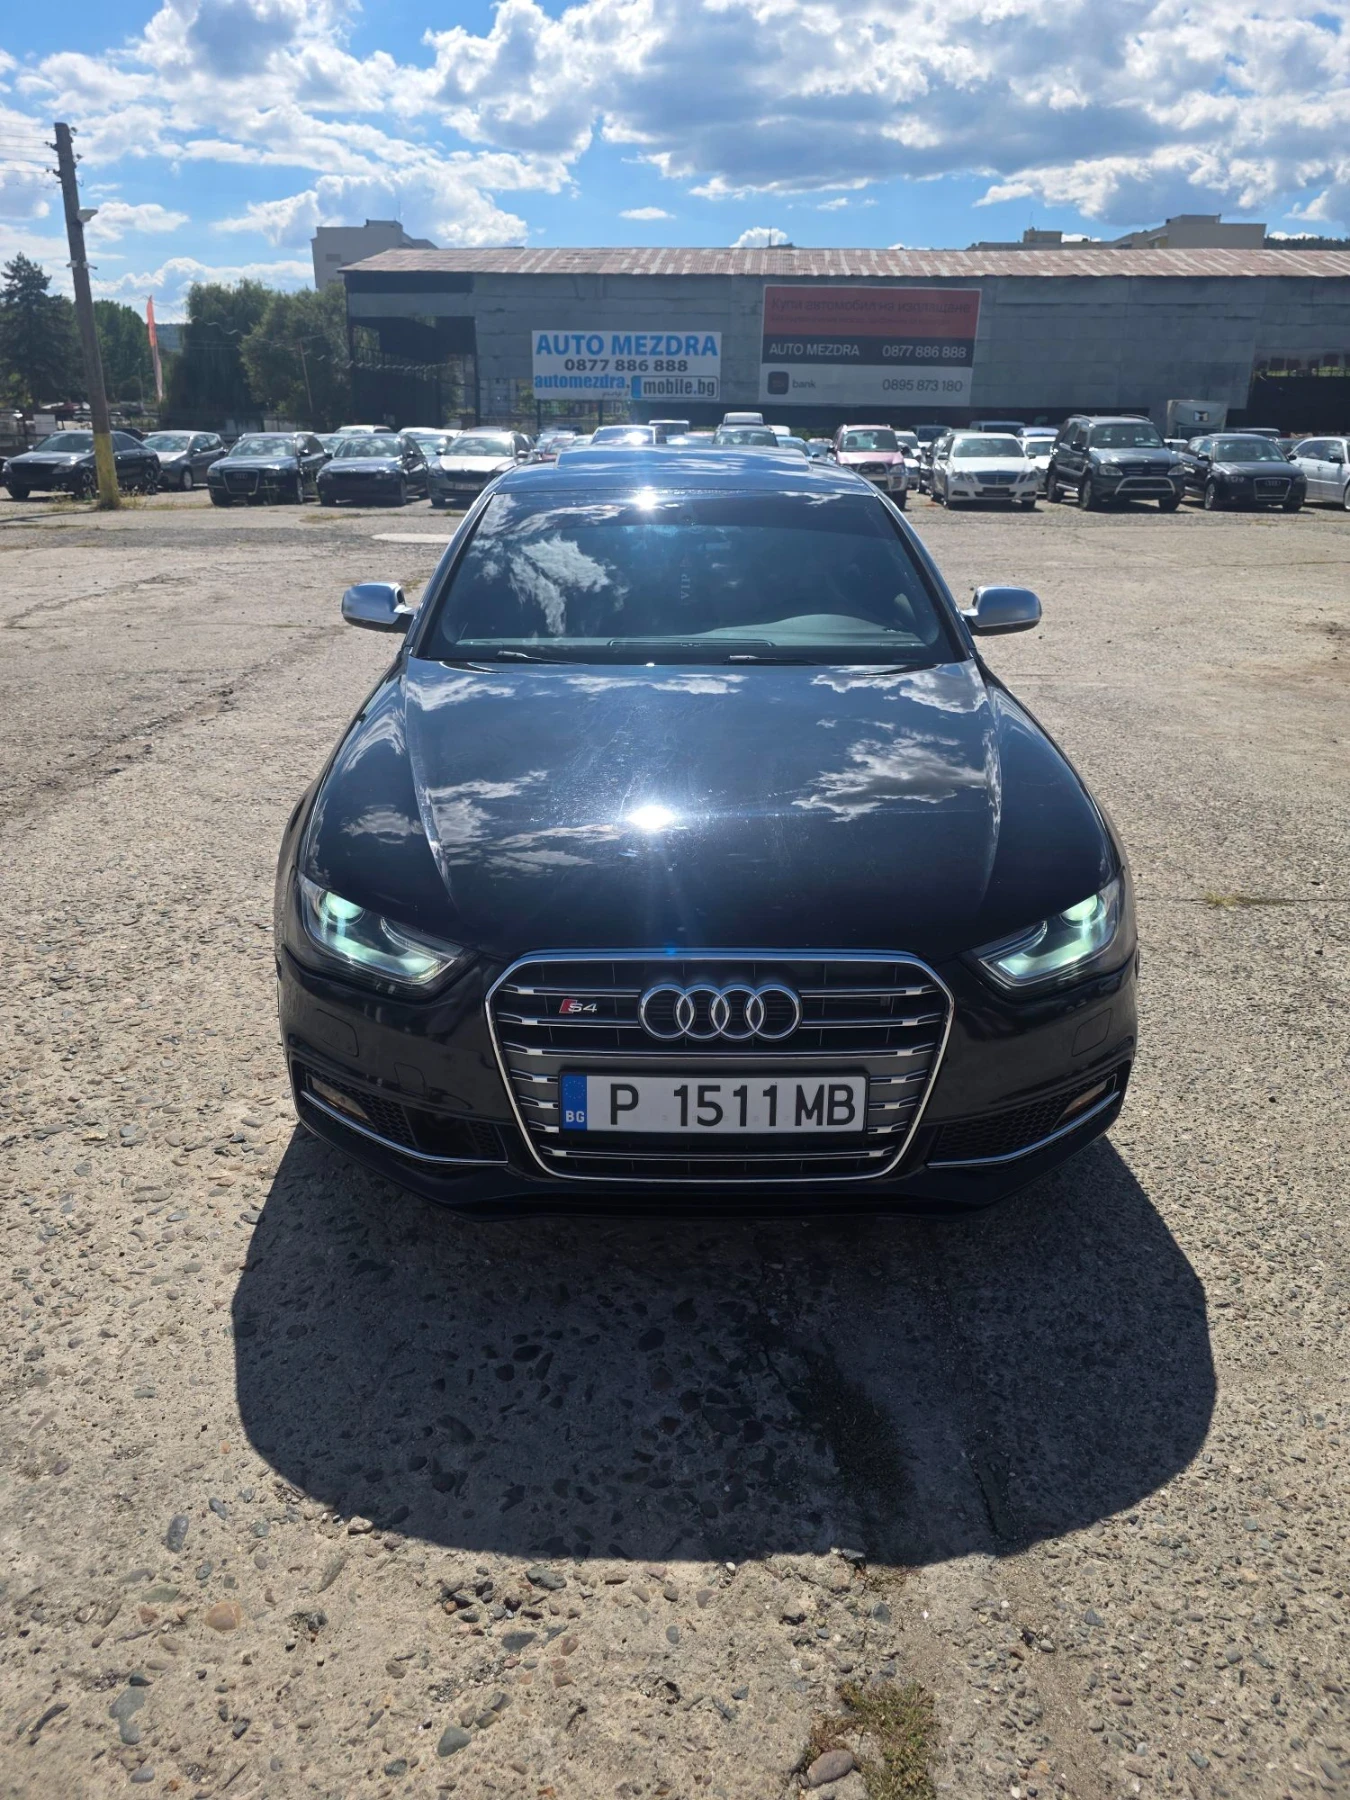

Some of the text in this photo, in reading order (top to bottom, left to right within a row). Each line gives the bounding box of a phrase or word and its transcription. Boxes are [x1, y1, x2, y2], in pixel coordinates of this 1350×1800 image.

[804, 299, 877, 312] автомобил
[879, 303, 895, 312] на
[536, 334, 718, 357] AUTO MEZDRA
[769, 343, 860, 356] AUTO MEZDRA
[882, 345, 967, 358] 0877 886 888
[564, 358, 689, 373] 0877 886 888
[643, 378, 716, 397] mobile.bg
[792, 378, 817, 389] bank
[882, 379, 963, 393] 0895 873 180
[567, 1002, 597, 1013] S4
[609, 1083, 640, 1126] P
[565, 1110, 585, 1123] BG
